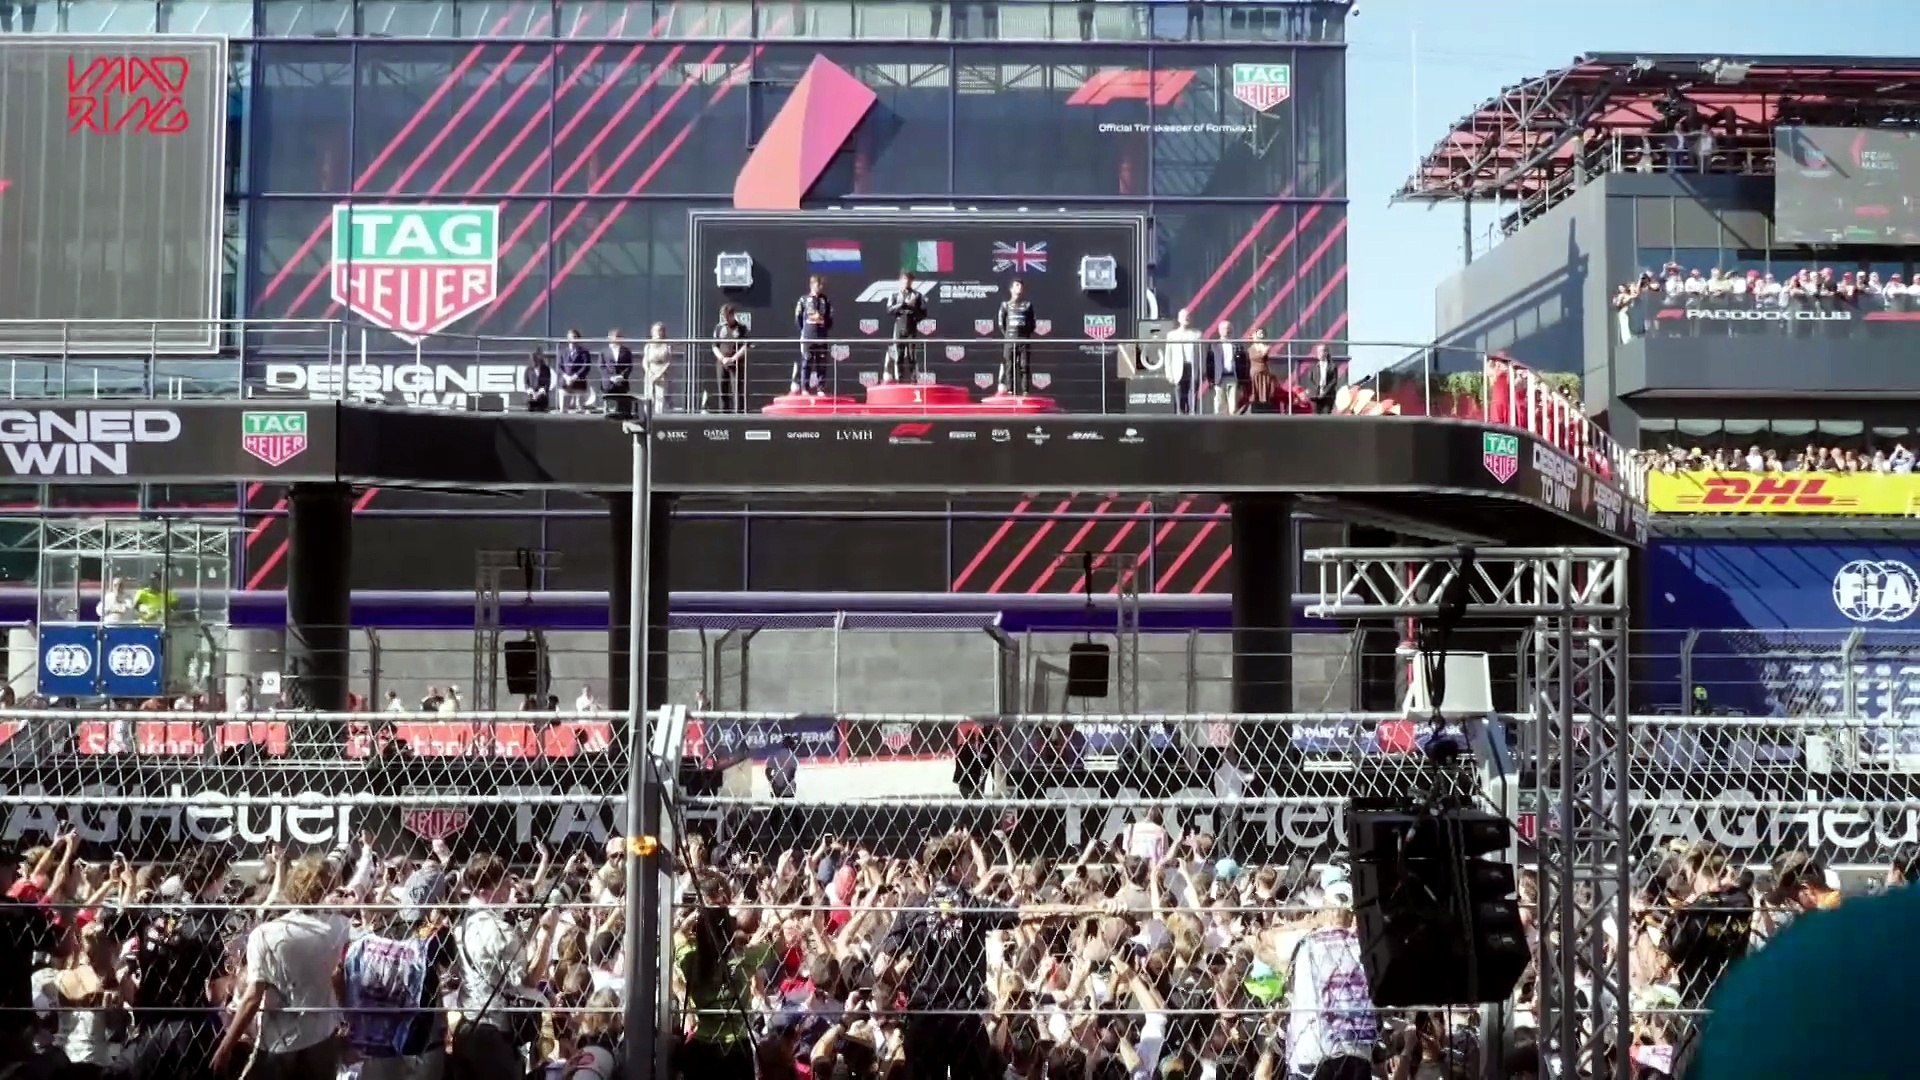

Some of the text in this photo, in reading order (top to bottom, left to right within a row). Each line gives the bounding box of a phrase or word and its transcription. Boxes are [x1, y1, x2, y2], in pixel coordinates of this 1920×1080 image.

[1237, 67, 1286, 82] TAG
[1237, 84, 1286, 108] HEUER
[1098, 123, 1132, 133] Official
[1194, 123, 1205, 133] of
[352, 214, 482, 256] TAG
[342, 267, 487, 332] HEUER
[1086, 314, 1113, 325] TAG
[1686, 309, 1791, 320] PADDOCK
[1795, 310, 1851, 320] CLUB
[265, 365, 556, 393] DESIGNED
[914, 390, 922, 402] 1
[0, 410, 181, 443] GNED
[248, 415, 301, 431] TAG
[836, 430, 873, 440] LVMH
[1487, 436, 1516, 455] TAG
[2, 443, 128, 474] WIN
[246, 436, 304, 462] HEUER
[1541, 475, 1553, 504] TO
[1702, 477, 1836, 505] DHL
[1839, 572, 1914, 609] FIA
[50, 648, 88, 671] FIA
[112, 648, 151, 671] FIA
